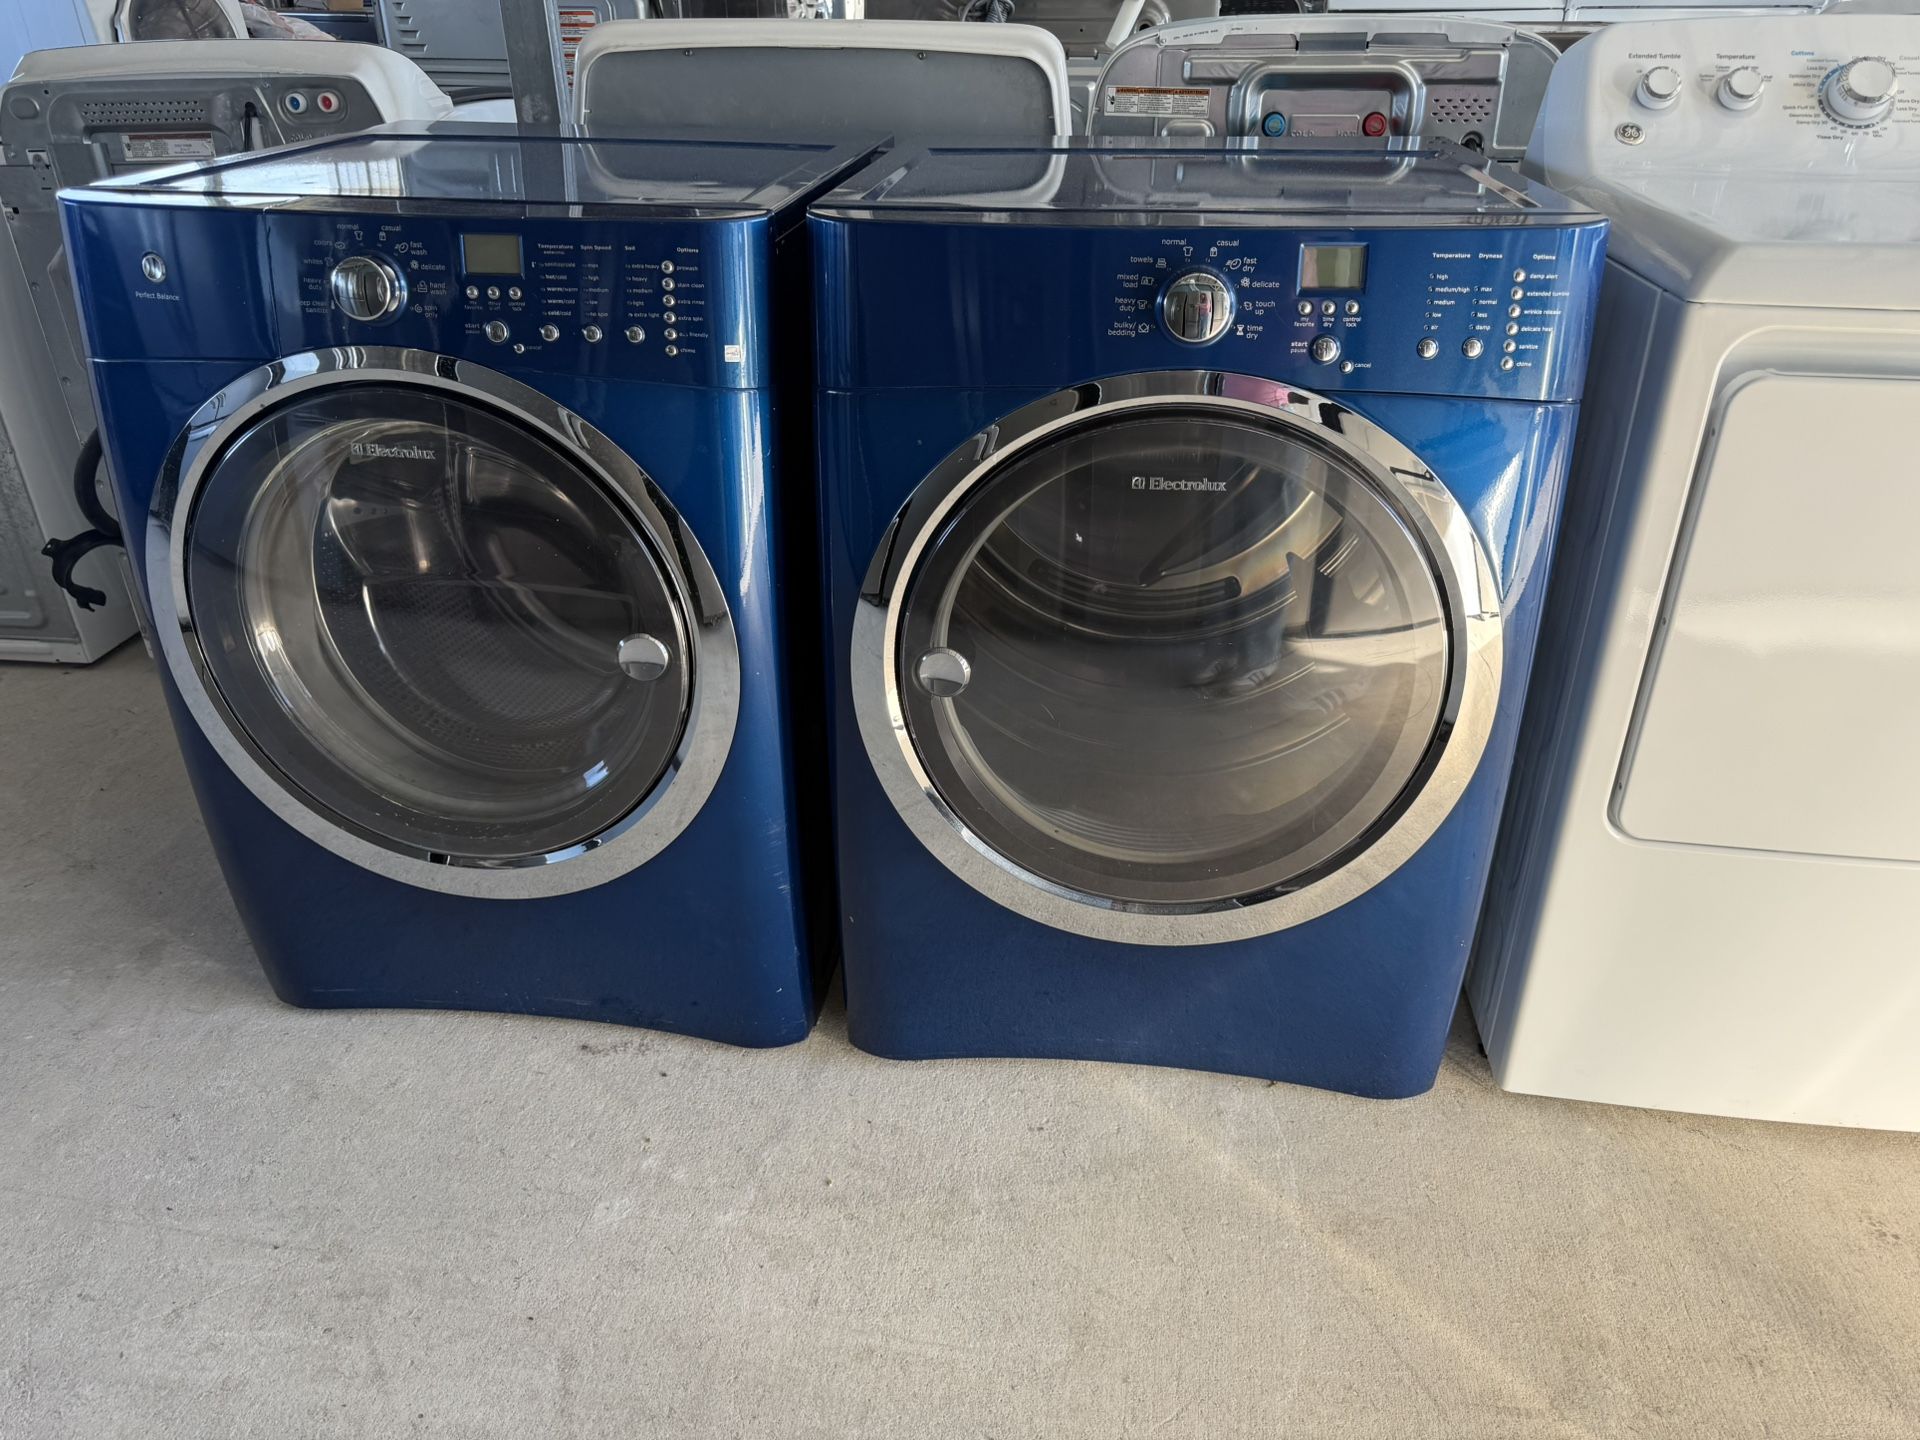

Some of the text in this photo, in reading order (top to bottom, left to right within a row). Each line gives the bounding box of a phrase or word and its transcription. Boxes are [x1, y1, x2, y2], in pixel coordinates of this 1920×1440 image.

[538, 243, 574, 251] Temperature
[1432, 252, 1471, 260] Temperature
[1478, 252, 1503, 260] Dryness
[1243, 257, 1258, 265] fast
[421, 263, 445, 271] delicate
[1242, 265, 1256, 273] dry
[1117, 273, 1139, 281] mixed
[1436, 273, 1449, 281] high
[1251, 280, 1280, 288] delicate
[1435, 286, 1471, 294] medium/high
[135, 291, 180, 301] Perfect Balance
[1115, 297, 1136, 305] heavy
[1119, 304, 1136, 312] duty
[1114, 321, 1136, 330] bulky/
[1475, 324, 1491, 332] damp
[1107, 329, 1136, 337] bedding
[1246, 332, 1259, 340] dry
[366, 443, 436, 460] Electrolux
[1149, 476, 1228, 492] Electrolux
